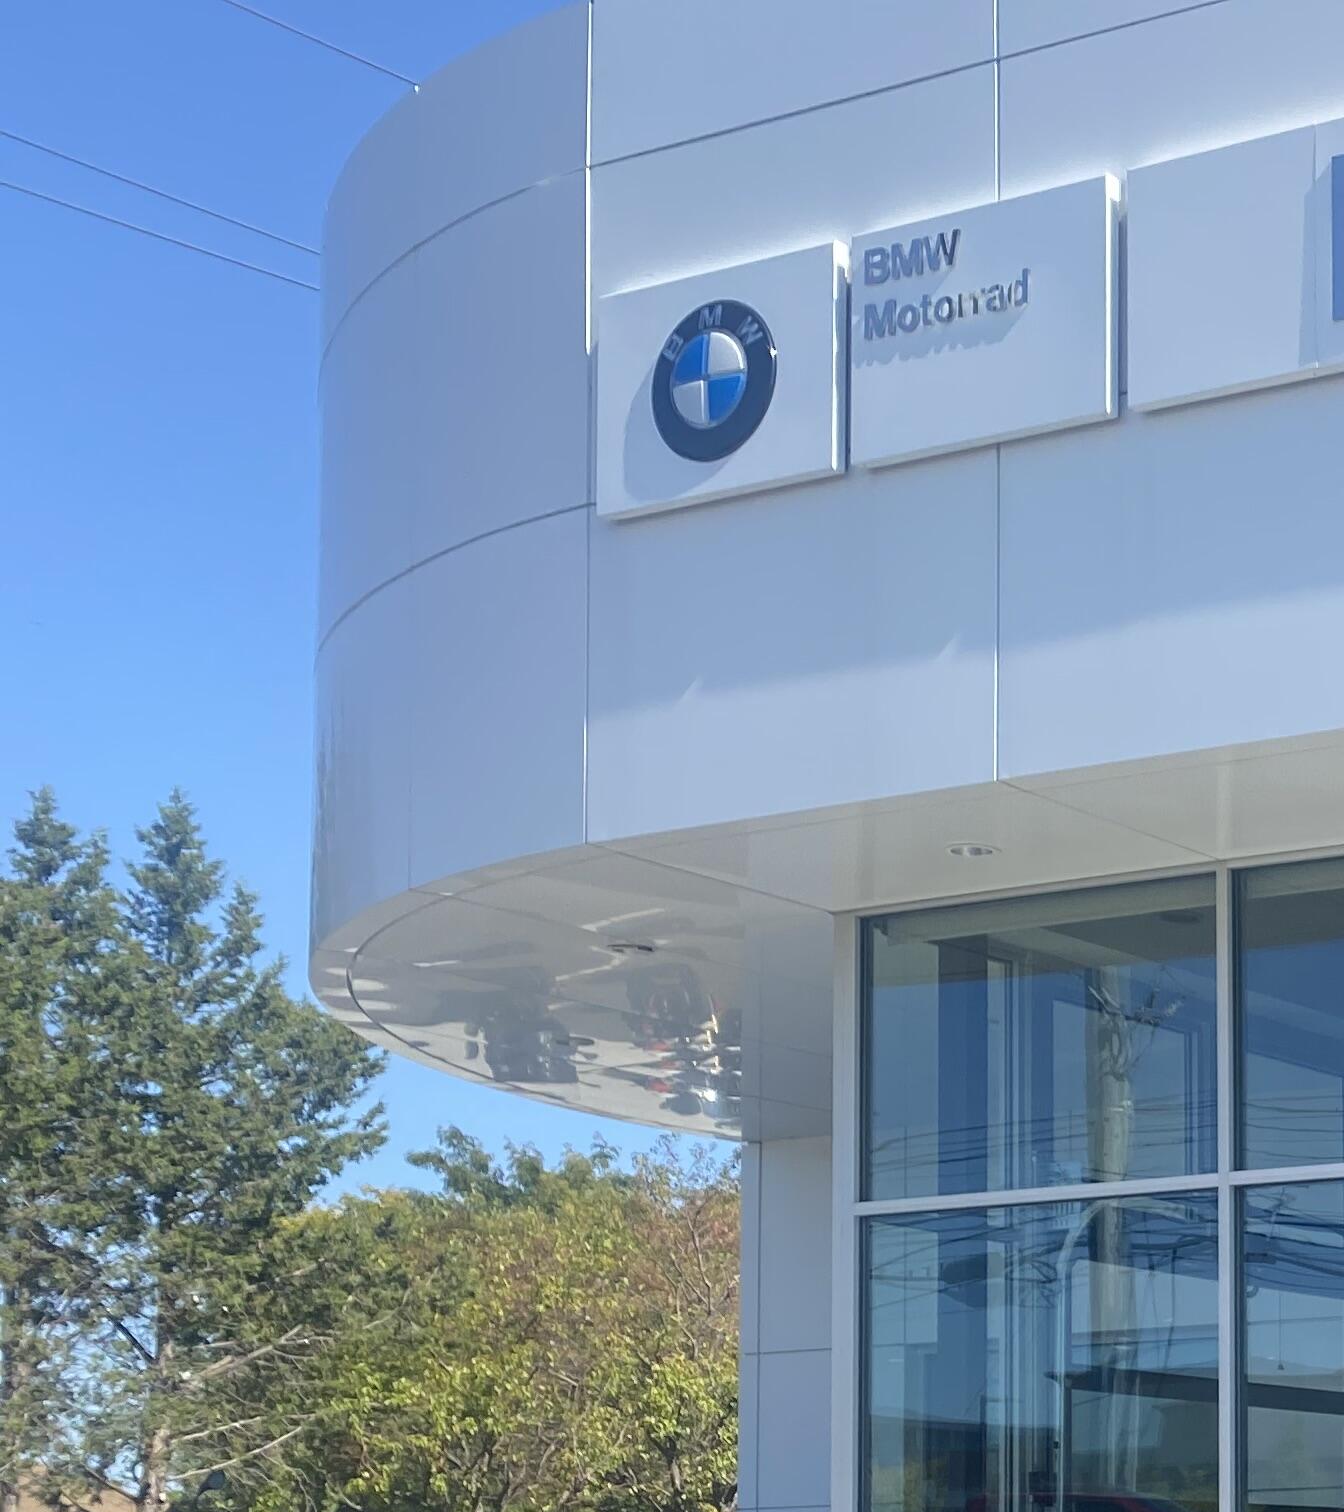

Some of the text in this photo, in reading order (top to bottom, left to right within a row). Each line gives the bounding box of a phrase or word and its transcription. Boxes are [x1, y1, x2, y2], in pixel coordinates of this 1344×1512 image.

[862, 229, 961, 286] BMW
[662, 304, 765, 359] BMW
[862, 268, 1031, 342] Motorrad
